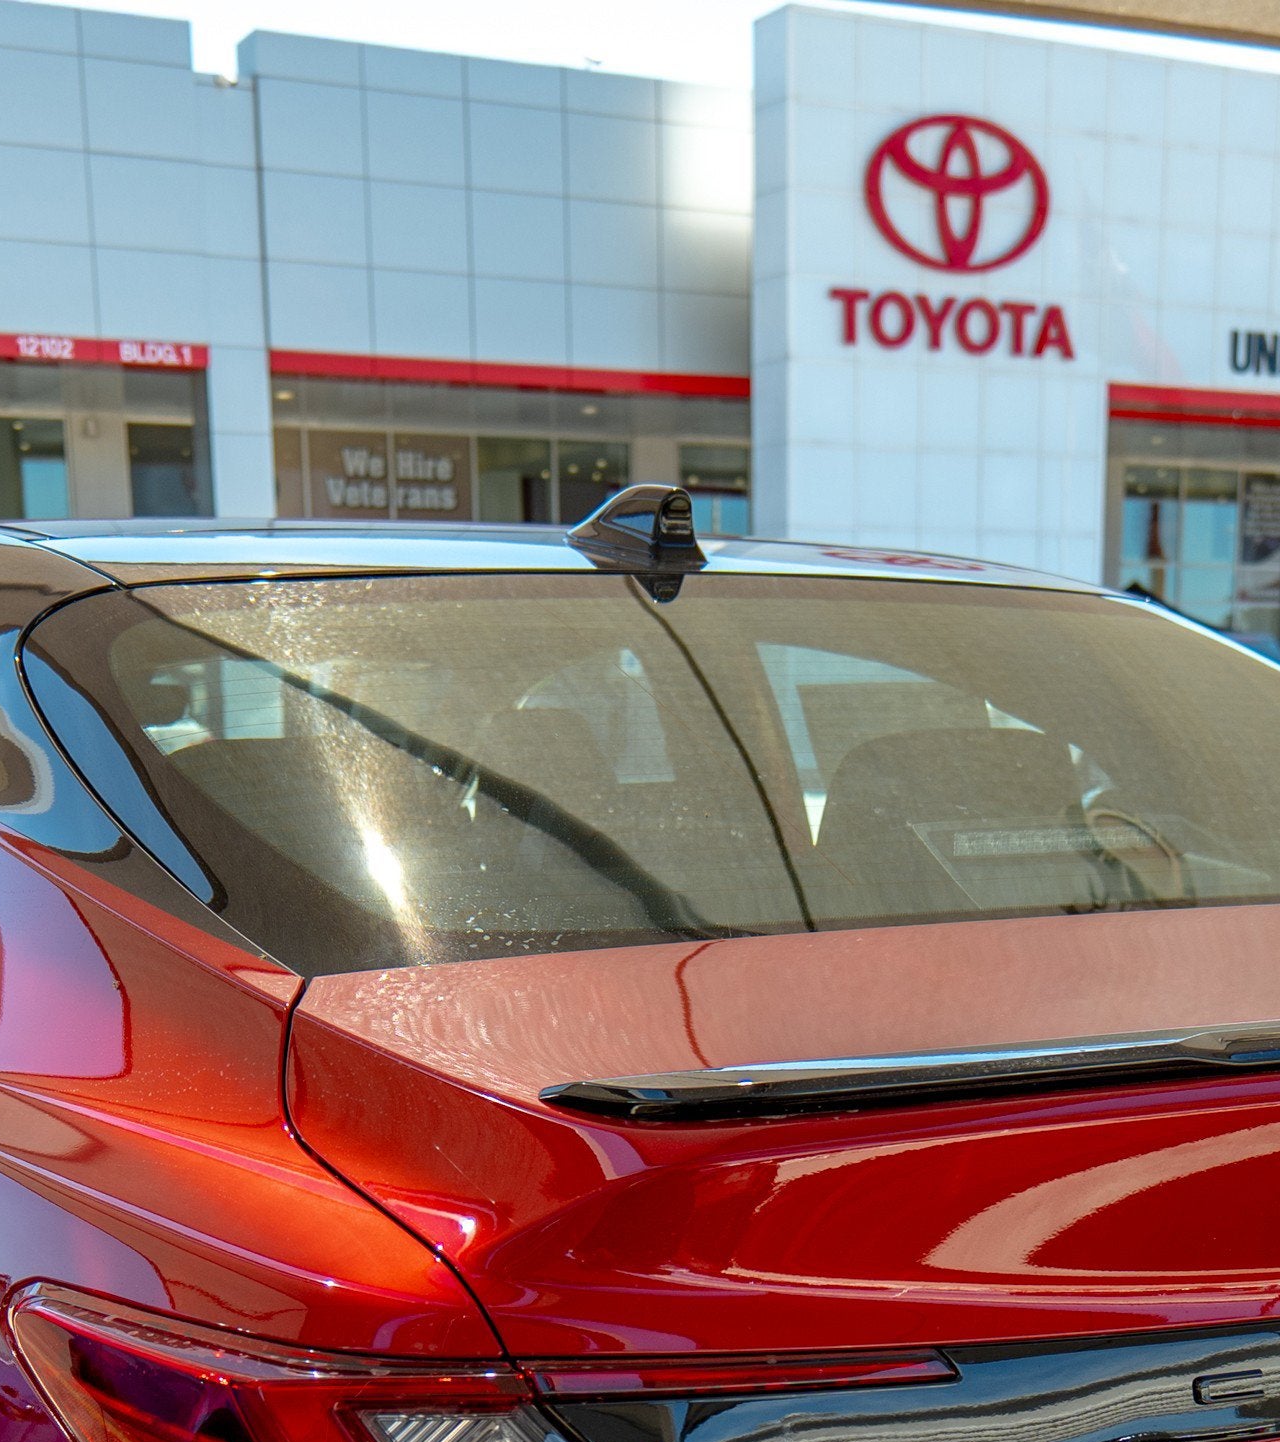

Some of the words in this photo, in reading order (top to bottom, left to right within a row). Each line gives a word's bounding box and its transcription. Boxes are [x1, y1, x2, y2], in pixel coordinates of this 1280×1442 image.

[828, 287, 1075, 360] TOYOTA
[17, 336, 74, 359] 12102
[181, 346, 192, 365] 1
[341, 446, 386, 479] We
[396, 449, 454, 482] Hire
[325, 474, 458, 510] Veterans
